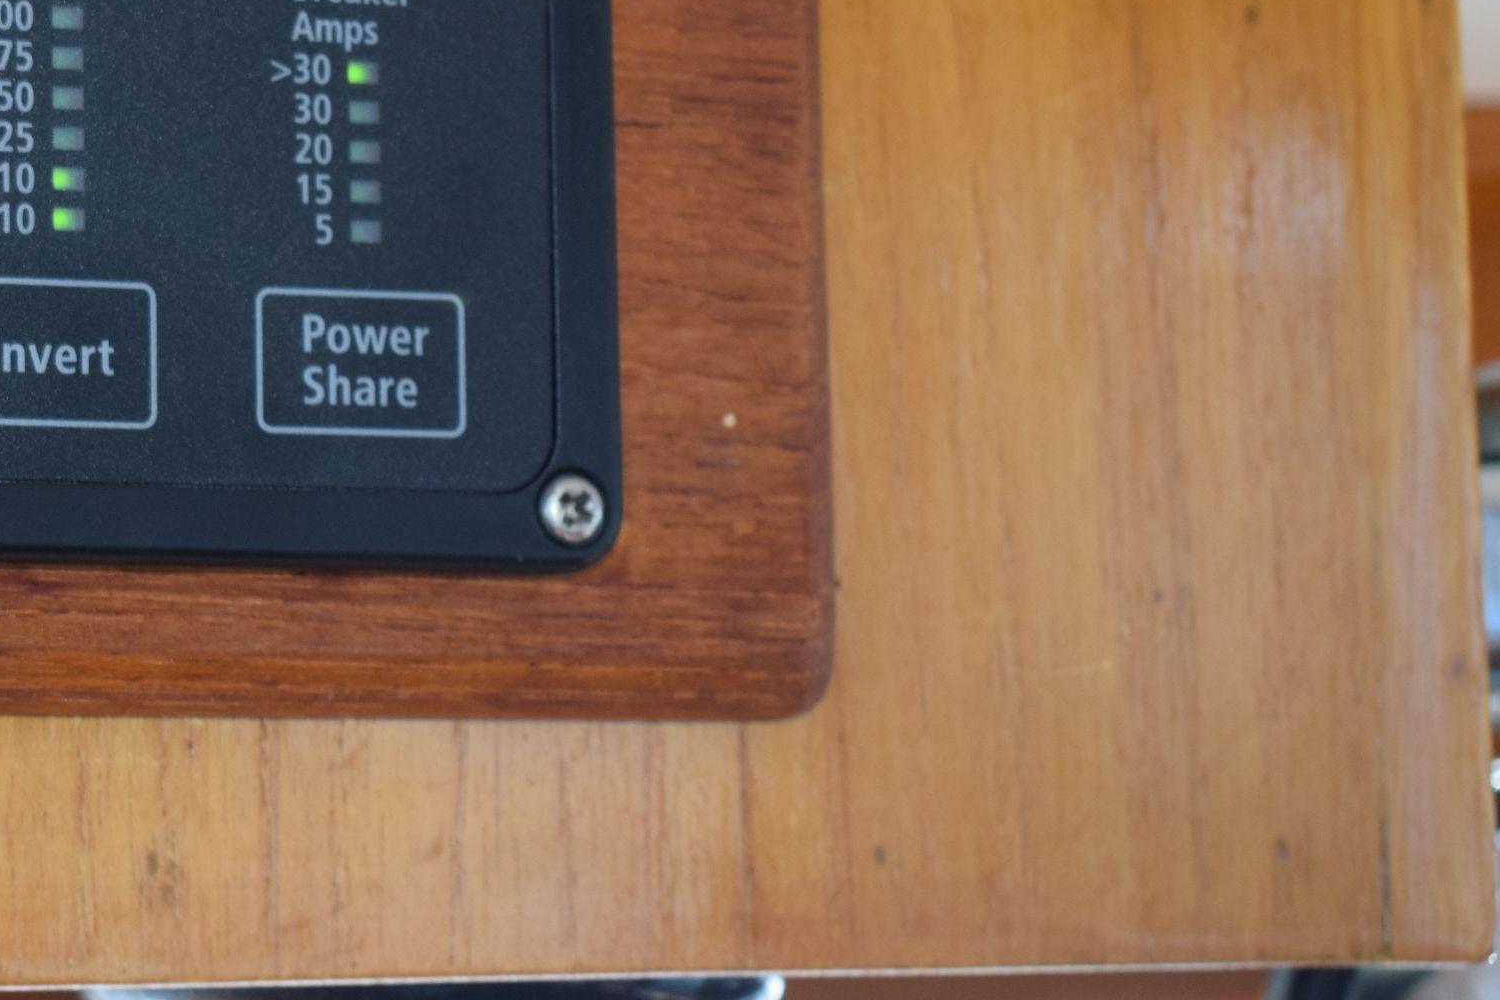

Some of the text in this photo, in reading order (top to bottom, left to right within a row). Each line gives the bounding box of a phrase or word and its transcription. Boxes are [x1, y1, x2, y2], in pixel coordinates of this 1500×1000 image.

[292, 11, 378, 52] Amps
[271, 53, 331, 85] >30
[295, 93, 331, 124] 30
[295, 133, 332, 165] 20
[297, 173, 332, 205] 15
[316, 214, 333, 245] 5
[302, 313, 429, 355] Power
[303, 364, 417, 407] Share
